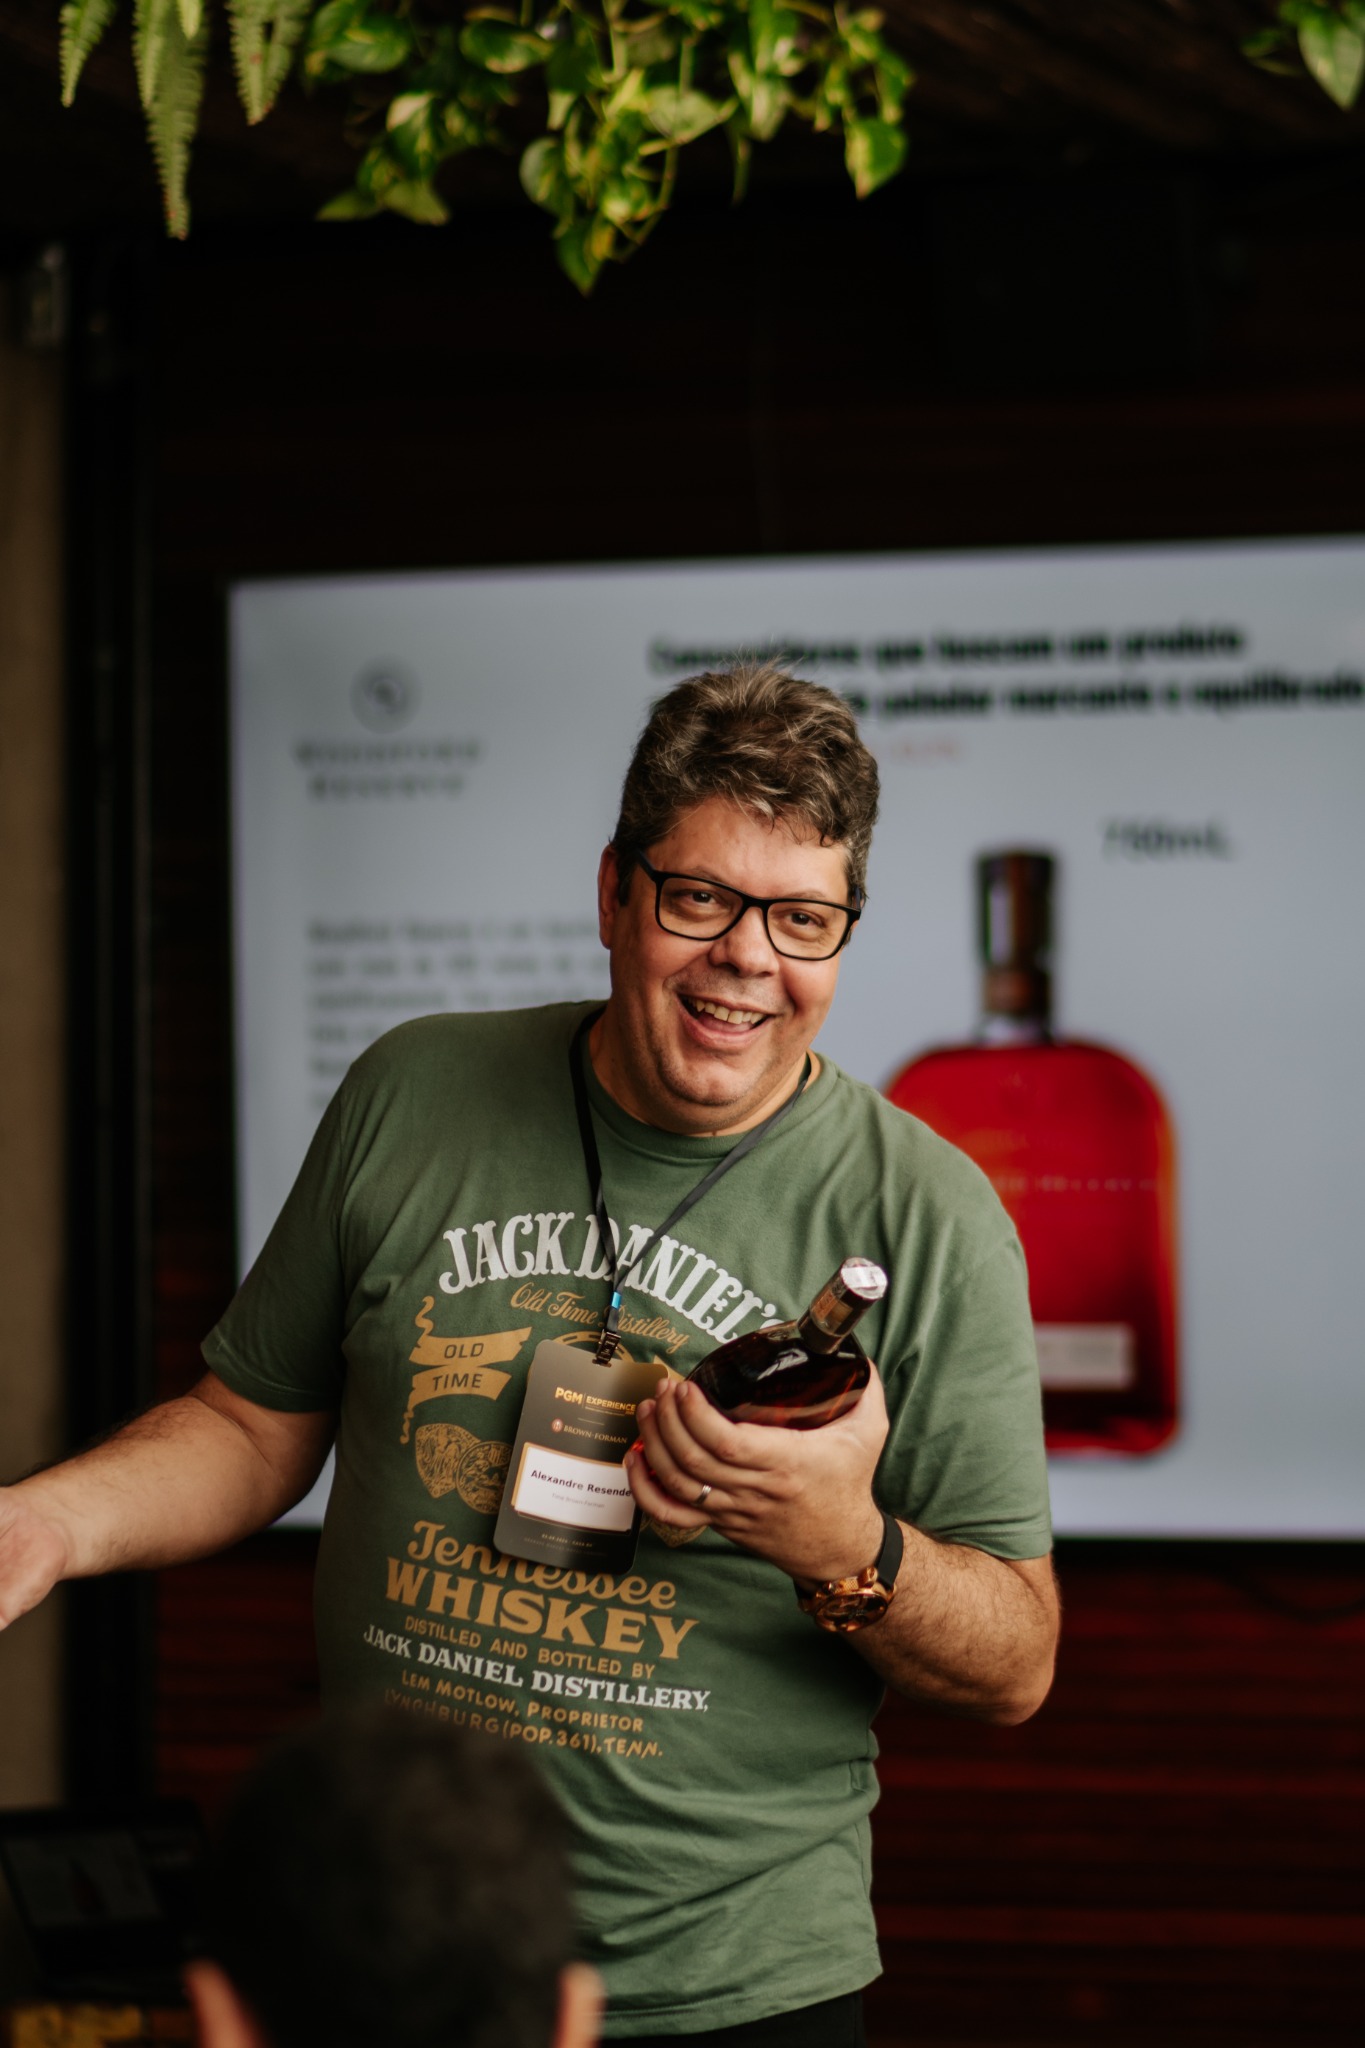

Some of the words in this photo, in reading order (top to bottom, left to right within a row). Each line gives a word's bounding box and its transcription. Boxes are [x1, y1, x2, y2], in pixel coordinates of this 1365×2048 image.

[438, 1211, 575, 1295] JACK
[510, 1282, 544, 1312] Old
[548, 1291, 595, 1325] Time
[432, 1372, 484, 1391] TIME
[443, 1342, 485, 1359] OLD
[555, 1386, 584, 1404] PGM
[585, 1395, 637, 1411] EXPERIENCE
[530, 1469, 584, 1491] Alexandre
[587, 1483, 633, 1497] Resende
[407, 1519, 677, 1610] Tennessee
[385, 1556, 700, 1660] WHISKEY
[363, 1624, 412, 1659] JACK
[417, 1642, 524, 1688] DANIEL
[531, 1669, 712, 1712] DISTILLERY,
[405, 1615, 482, 1648] DISTILLED
[489, 1638, 528, 1660] AND
[538, 1649, 622, 1676] BOTTLED
[631, 1662, 656, 1679] BY
[402, 1669, 431, 1691] LEM
[435, 1679, 521, 1717] MOTLOW,
[526, 1700, 644, 1733] PROPRIETOR
